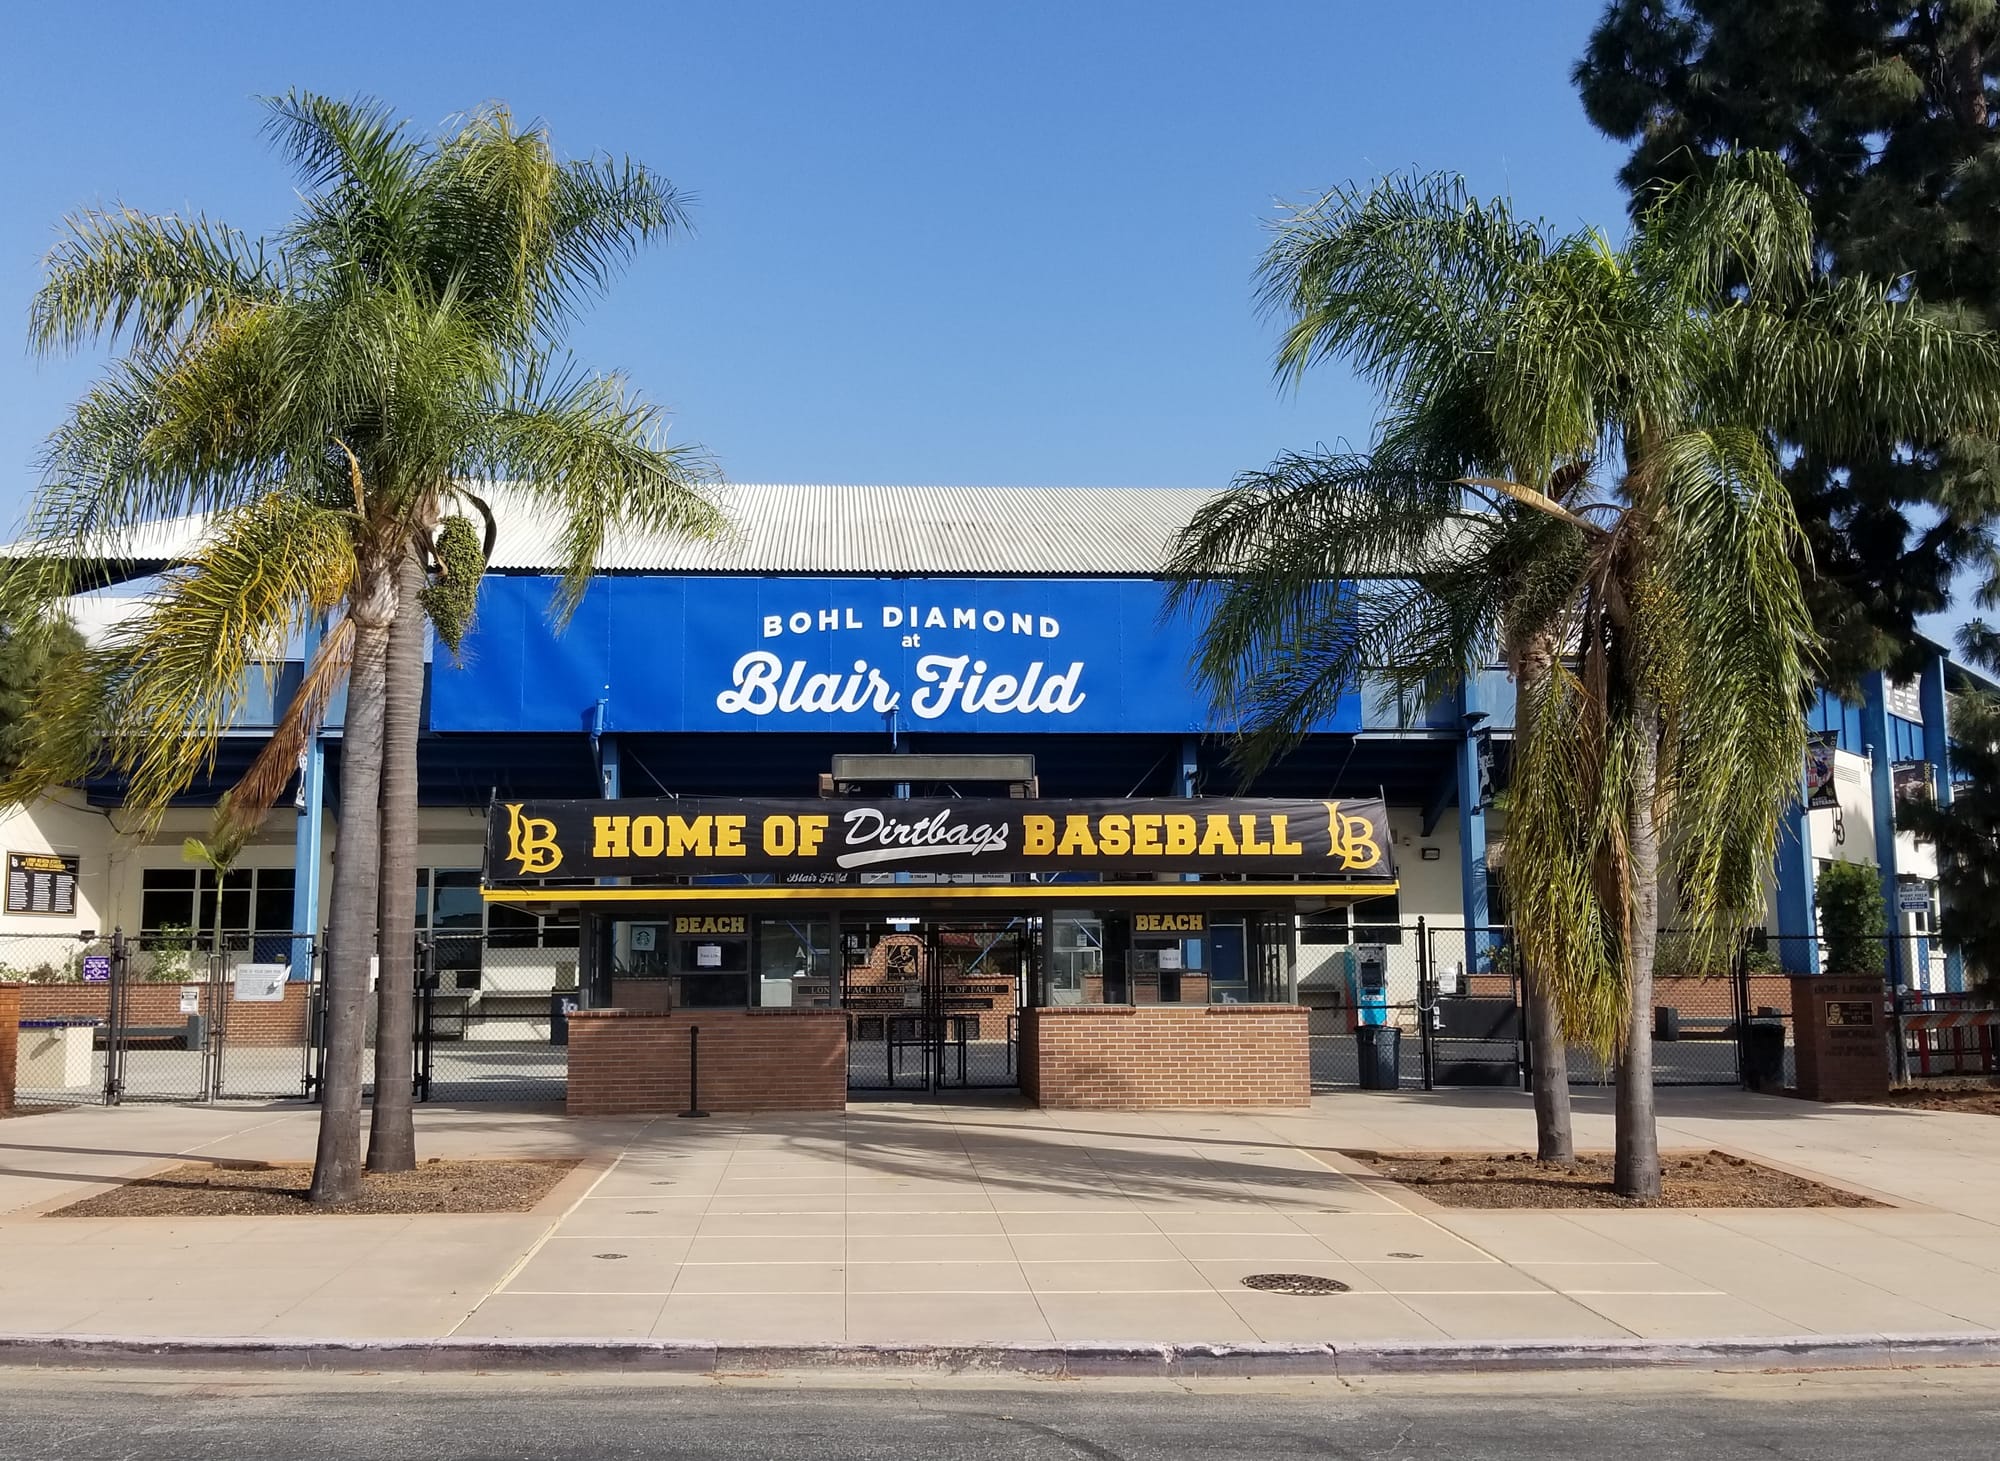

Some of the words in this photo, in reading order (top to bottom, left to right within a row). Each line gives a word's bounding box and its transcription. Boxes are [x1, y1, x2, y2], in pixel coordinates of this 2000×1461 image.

[763, 607, 863, 638] BOHL
[882, 606, 1060, 639] DIAMOND
[901, 633, 921, 648] at
[716, 651, 900, 715] Blair
[911, 654, 1086, 719] Field
[593, 815, 747, 858] HOME
[763, 815, 829, 857] OF
[842, 807, 1010, 859] Dirtbags
[1023, 814, 1303, 857] BASEBALL
[786, 872, 817, 882] Blair
[819, 871, 848, 883] Fild
[675, 916, 745, 933] BEACH
[1135, 914, 1204, 931] BEACH
